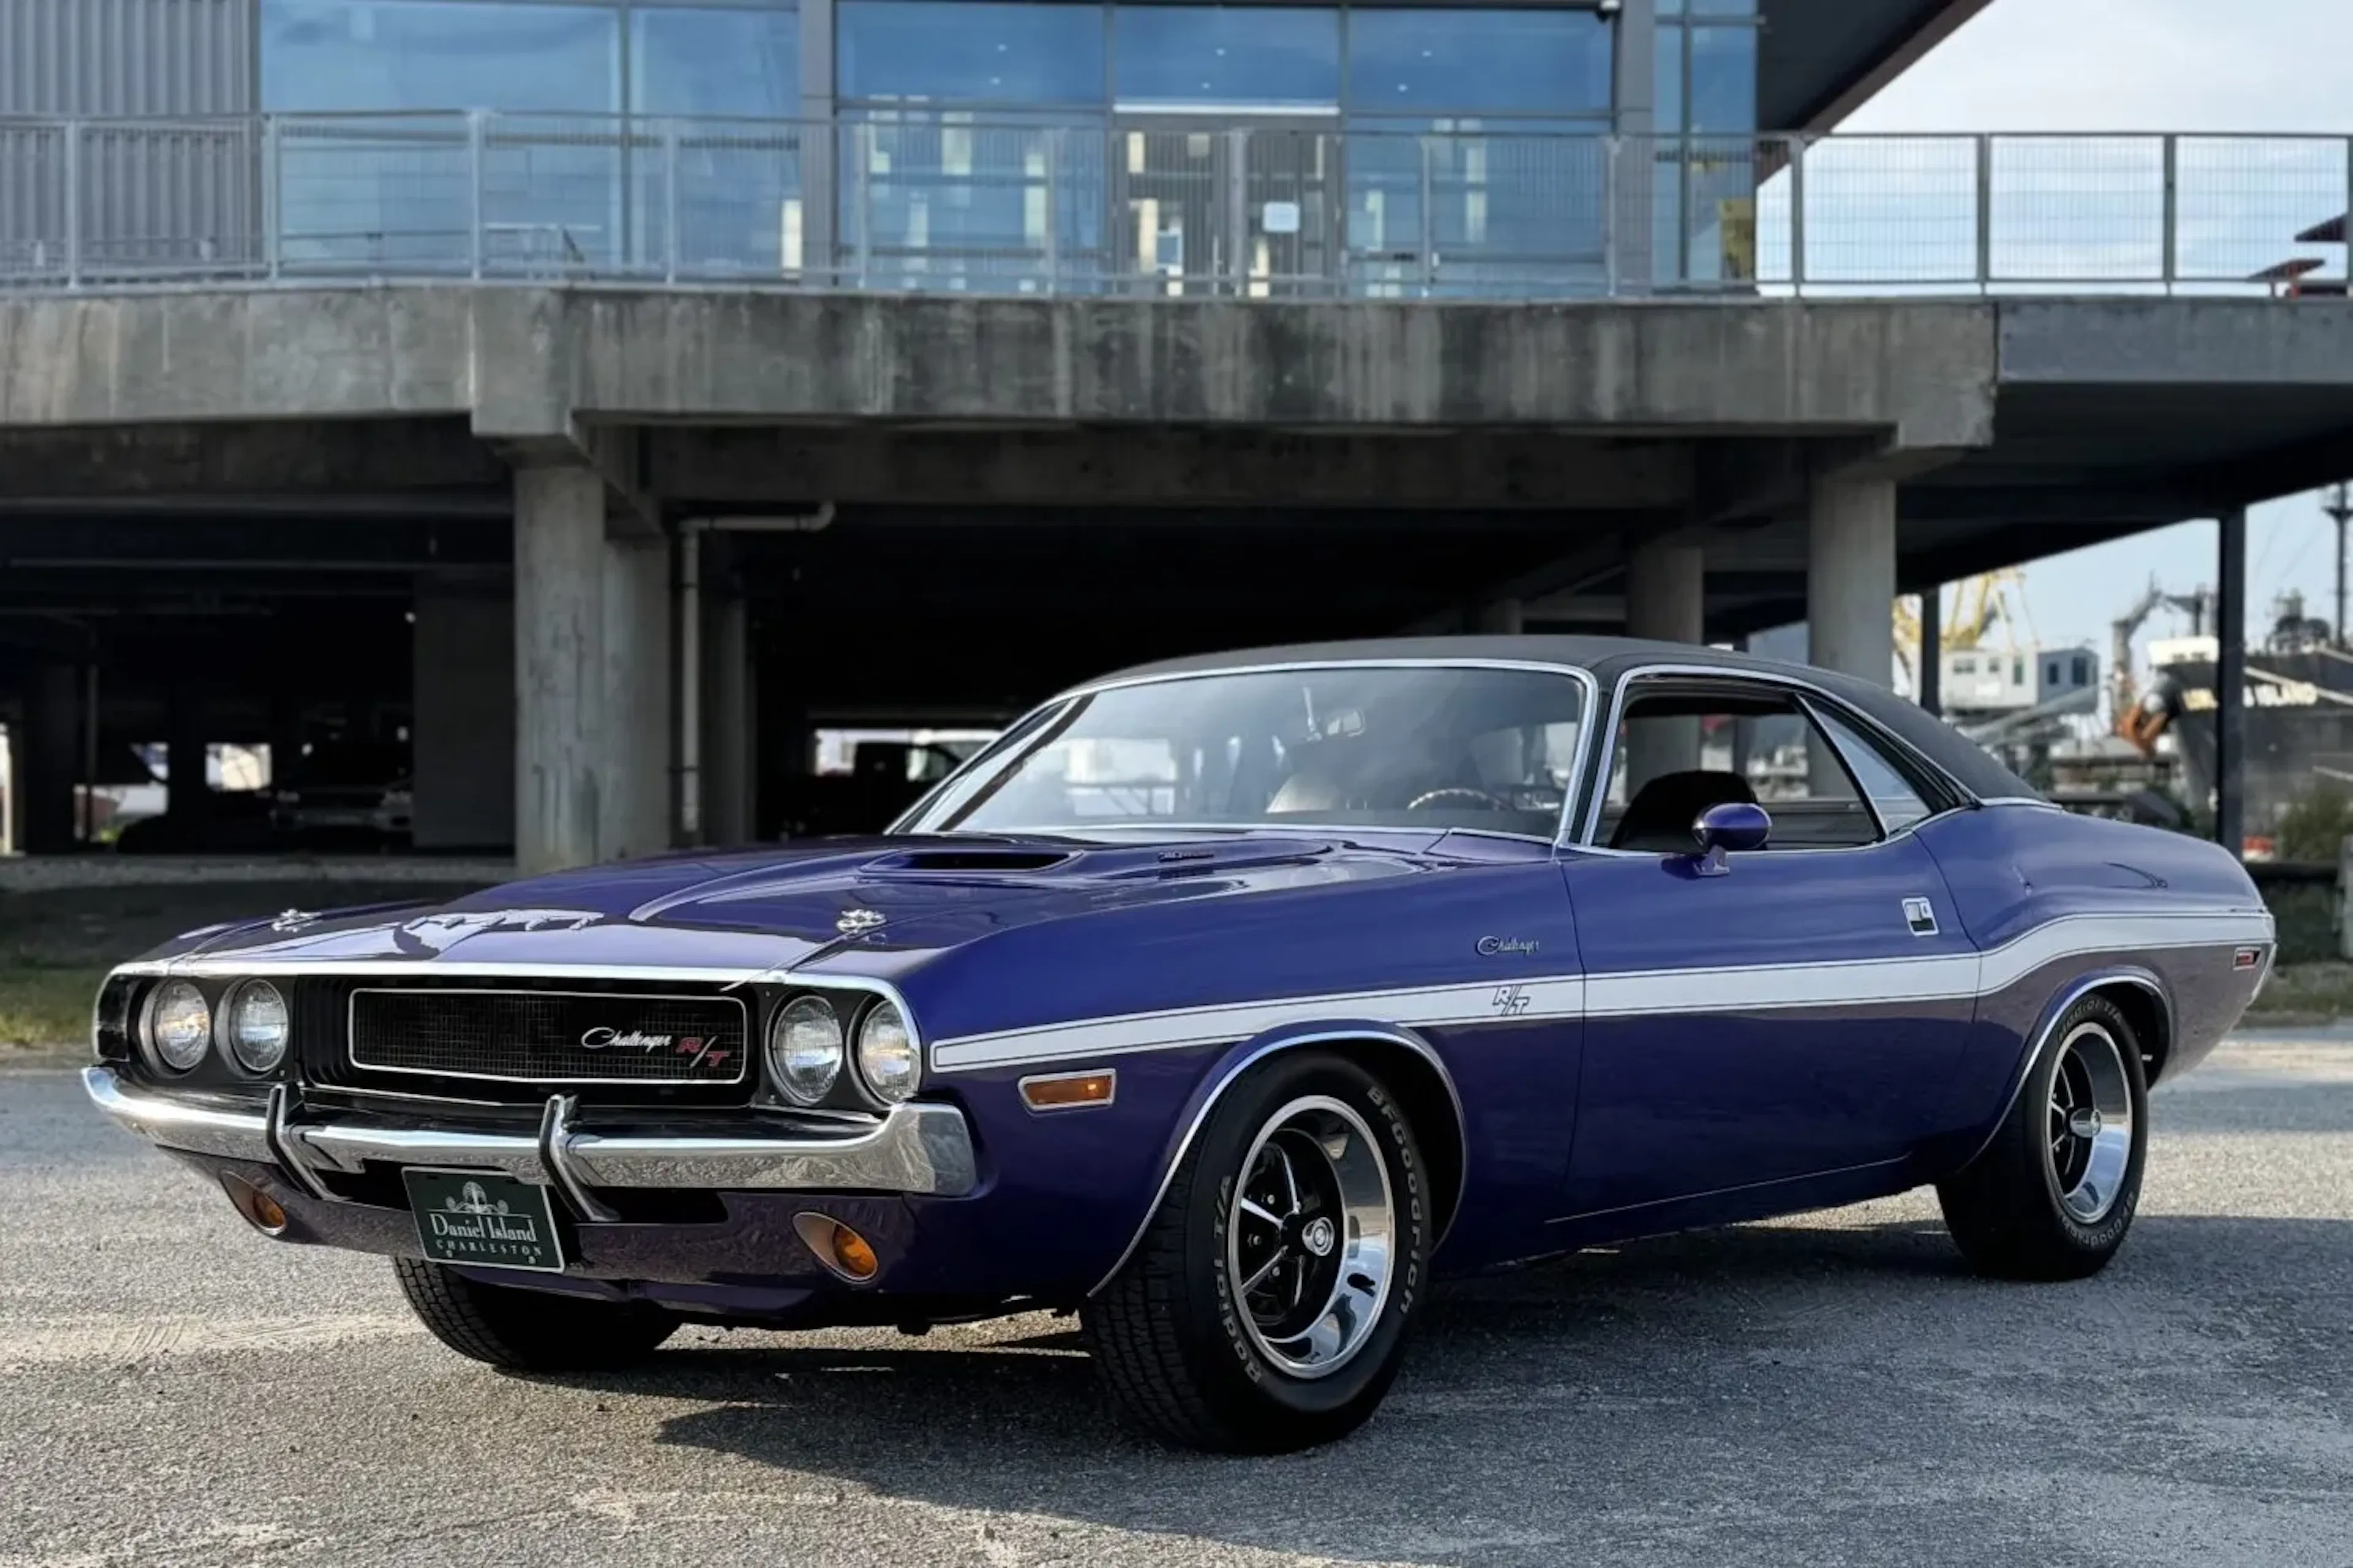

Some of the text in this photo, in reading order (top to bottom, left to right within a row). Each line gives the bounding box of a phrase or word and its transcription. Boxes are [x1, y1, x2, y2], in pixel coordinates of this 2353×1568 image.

[1492, 985, 1531, 1016] R/T
[582, 1027, 731, 1067] Challenger R/T
[430, 1213, 537, 1242] Daniel Island
[436, 1239, 542, 1256] CHARLESTON
